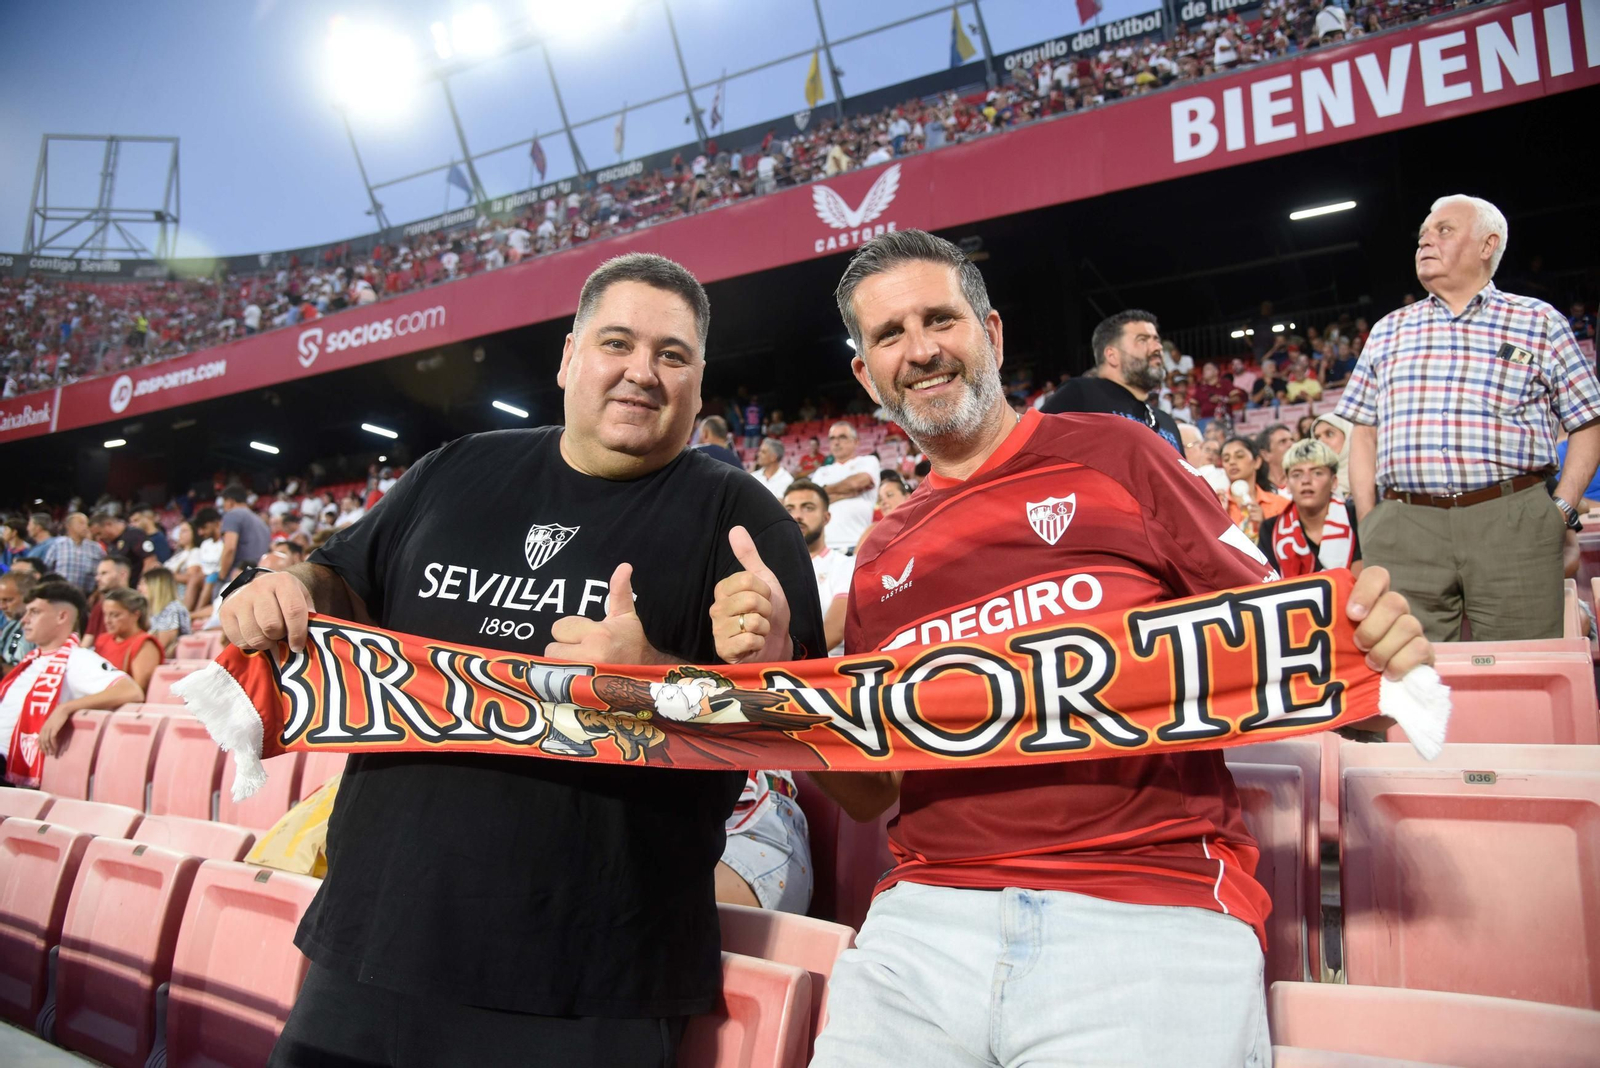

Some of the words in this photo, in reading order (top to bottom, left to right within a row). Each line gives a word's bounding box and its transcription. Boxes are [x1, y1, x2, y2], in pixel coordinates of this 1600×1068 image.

[1181, 1, 1207, 21] de
[1071, 28, 1100, 52] del
[1104, 11, 1162, 42] fútbol
[325, 305, 446, 353] SOCIOS.com
[418, 562, 566, 614] SEVILLA
[880, 580, 913, 603] CASTORE
[920, 573, 1103, 646] DEGIRO
[479, 616, 535, 641] 1890
[763, 577, 1343, 757] NORTE
[1474, 657, 1492, 665] 036
[1468, 773, 1491, 783] 036
